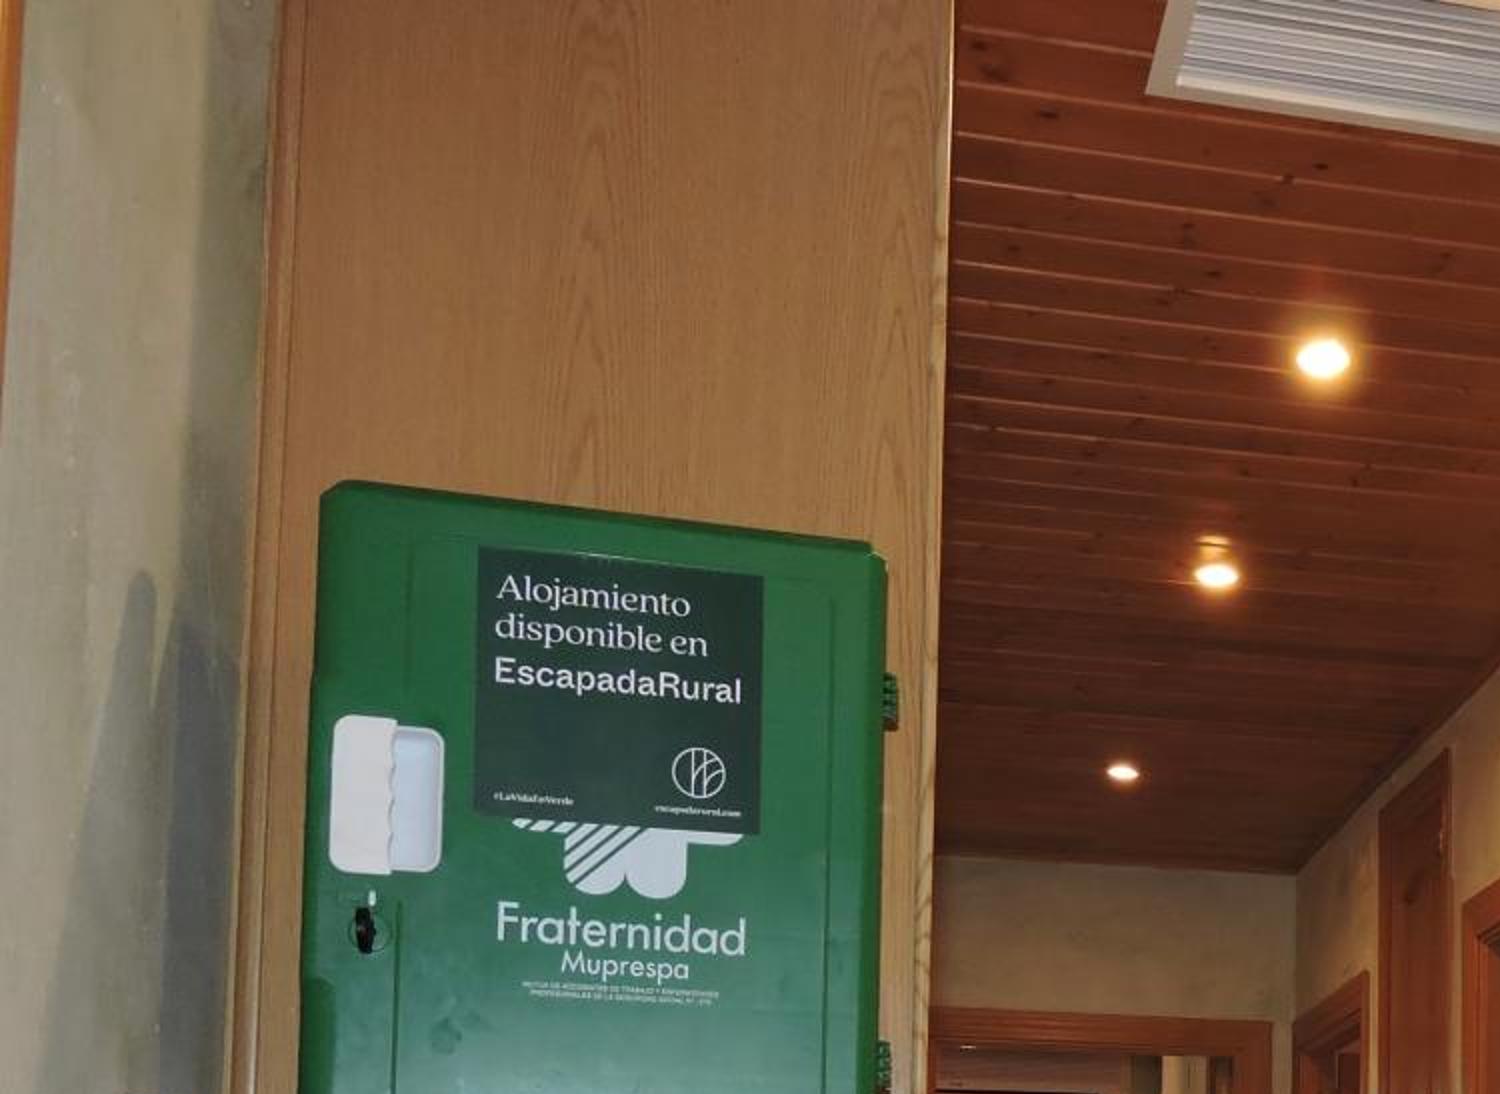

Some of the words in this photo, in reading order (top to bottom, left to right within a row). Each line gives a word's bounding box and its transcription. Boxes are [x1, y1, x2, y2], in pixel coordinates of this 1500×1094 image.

[496, 574, 692, 617] Alojamiento
[495, 613, 662, 653] disponible
[669, 634, 708, 657] en
[494, 656, 742, 704] EscapadaRural
[496, 900, 746, 956] Fraternidad
[560, 950, 690, 985] Muprespa
